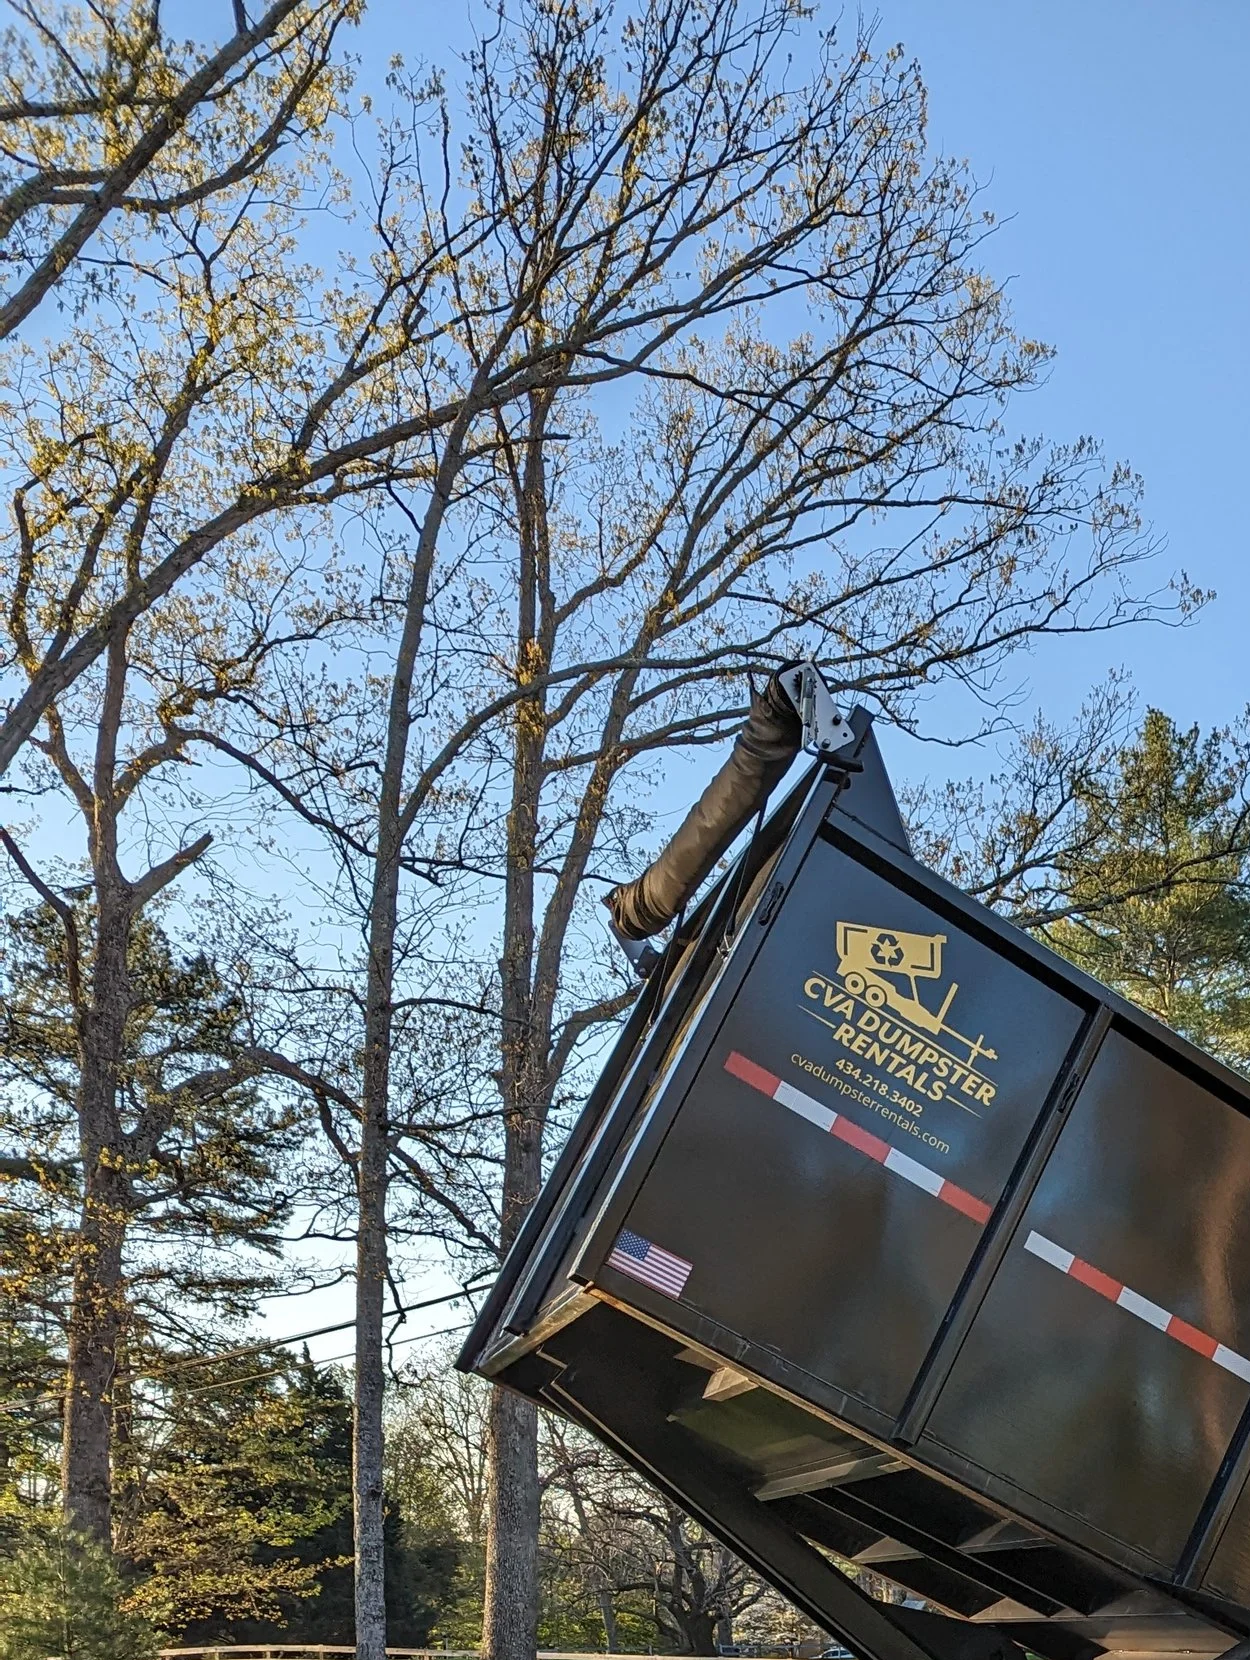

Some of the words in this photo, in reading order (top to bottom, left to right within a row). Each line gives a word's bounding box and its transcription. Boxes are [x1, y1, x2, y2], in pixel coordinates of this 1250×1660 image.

[803, 976, 855, 1021] CVA
[856, 1009, 997, 1107] DUMPSTER
[832, 1022, 948, 1102] RENTALS
[790, 1053, 951, 1154] cvadumpsterrentals.com
[835, 1058, 924, 1118] 434.218.3402
